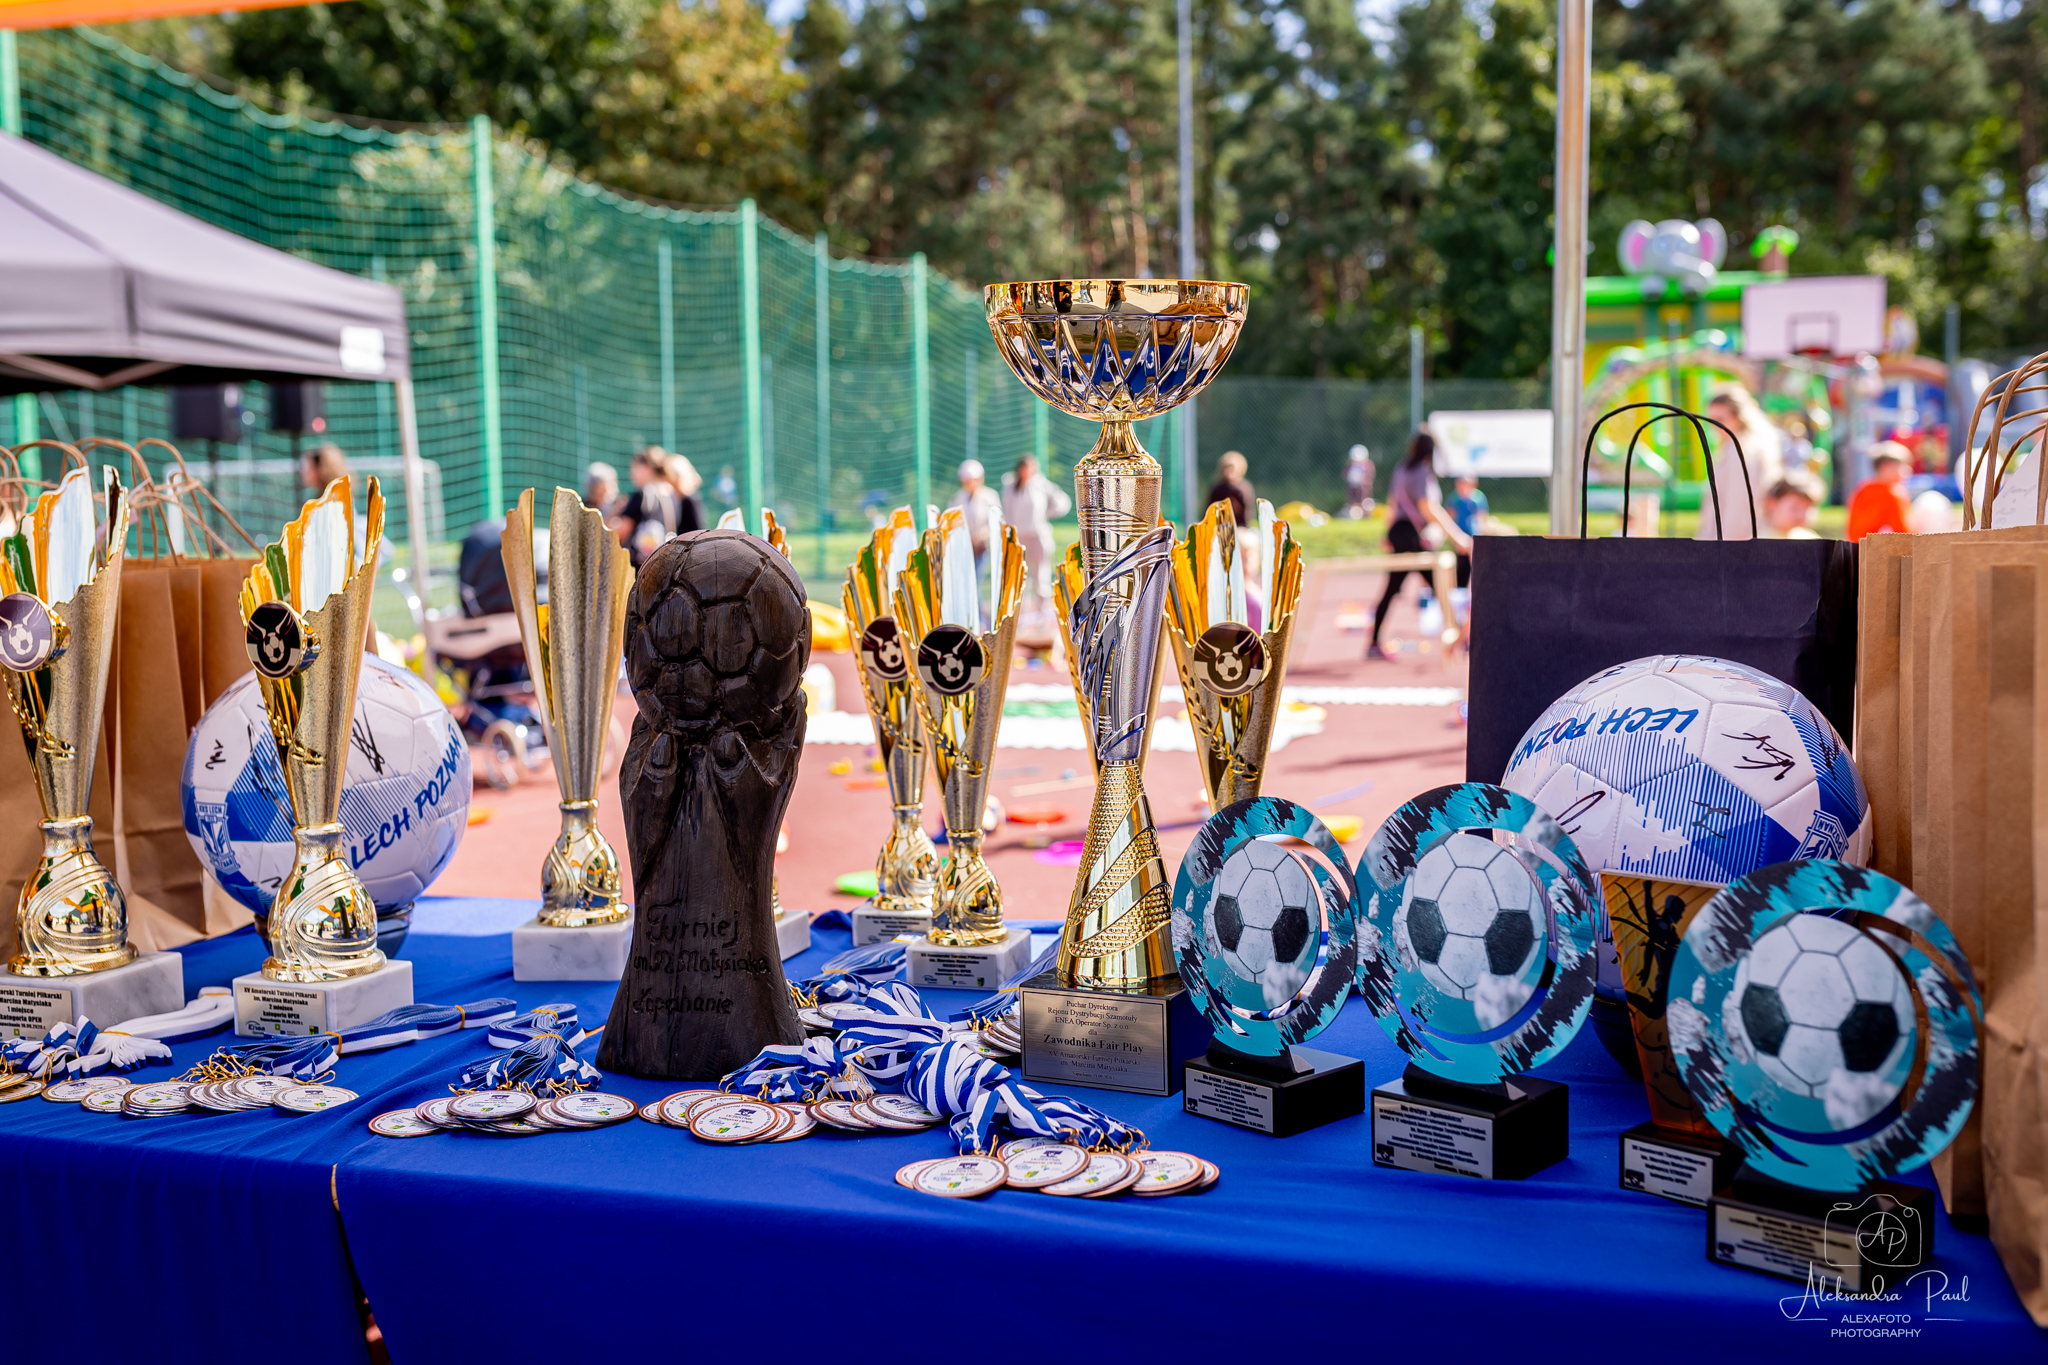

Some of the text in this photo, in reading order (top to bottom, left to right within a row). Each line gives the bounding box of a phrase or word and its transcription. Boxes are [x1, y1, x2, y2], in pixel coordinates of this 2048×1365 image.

[1597, 706, 1699, 734] LECH
[351, 807, 410, 870] LECH
[645, 897, 739, 949] Turniej
[11, 1006, 34, 1014] miejsce
[1066, 1000, 1118, 1012] Puchar Dyrektora
[1047, 1006, 1137, 1023] Rejonu Dystrybucji Szamotuły
[1055, 1016, 1074, 1025] ENEA
[1075, 1018, 1101, 1027] Operator
[1102, 1021, 1112, 1030] Sp.
[1088, 1028, 1098, 1036] dla
[1043, 1033, 1144, 1055] Zawodnika Fair Play
[1060, 1051, 1090, 1061] Amatorski
[1071, 1060, 1096, 1069] Marcina
[1097, 1063, 1128, 1073] Matysiaka
